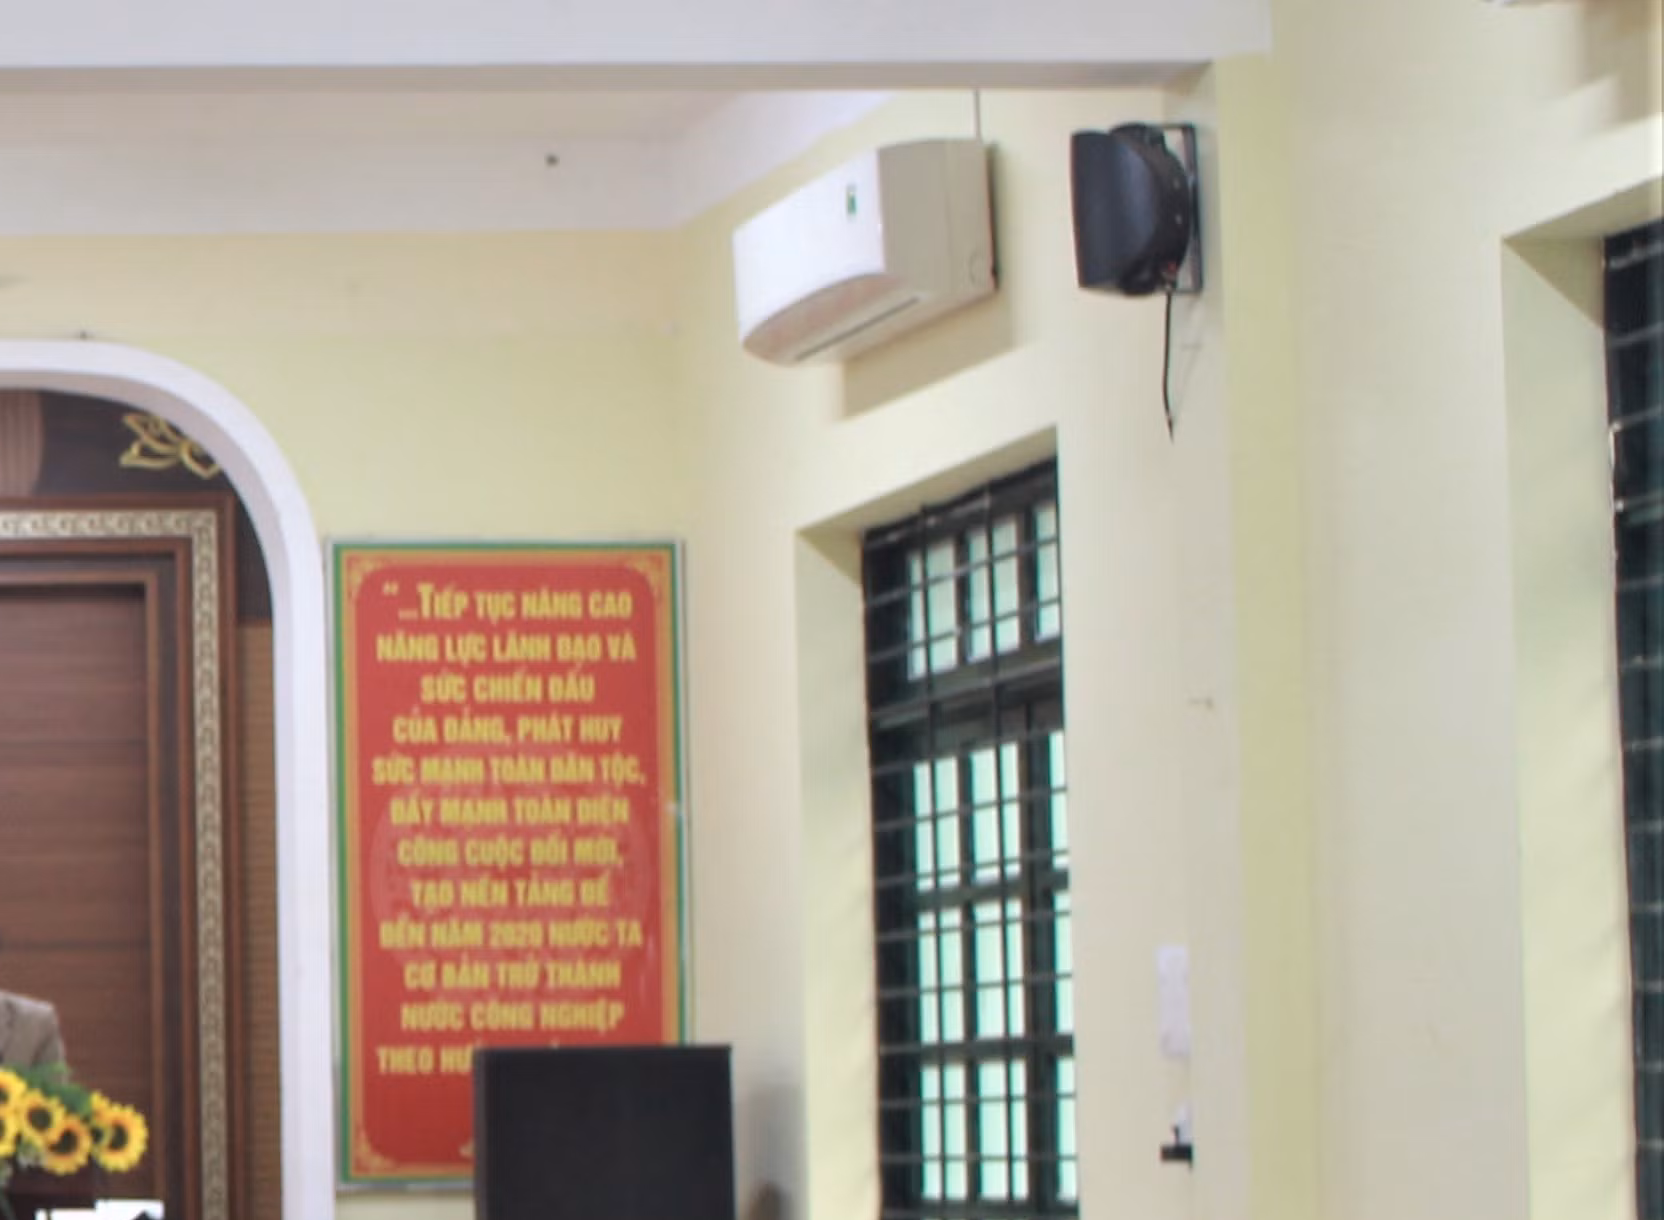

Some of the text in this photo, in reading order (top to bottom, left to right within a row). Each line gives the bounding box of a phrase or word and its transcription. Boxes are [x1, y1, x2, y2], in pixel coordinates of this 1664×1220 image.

[589, 592, 632, 618] CAO
[608, 633, 635, 660] VÀ
[580, 717, 621, 742] HUY
[615, 920, 642, 945] TA
[378, 1048, 433, 1072] THEO
